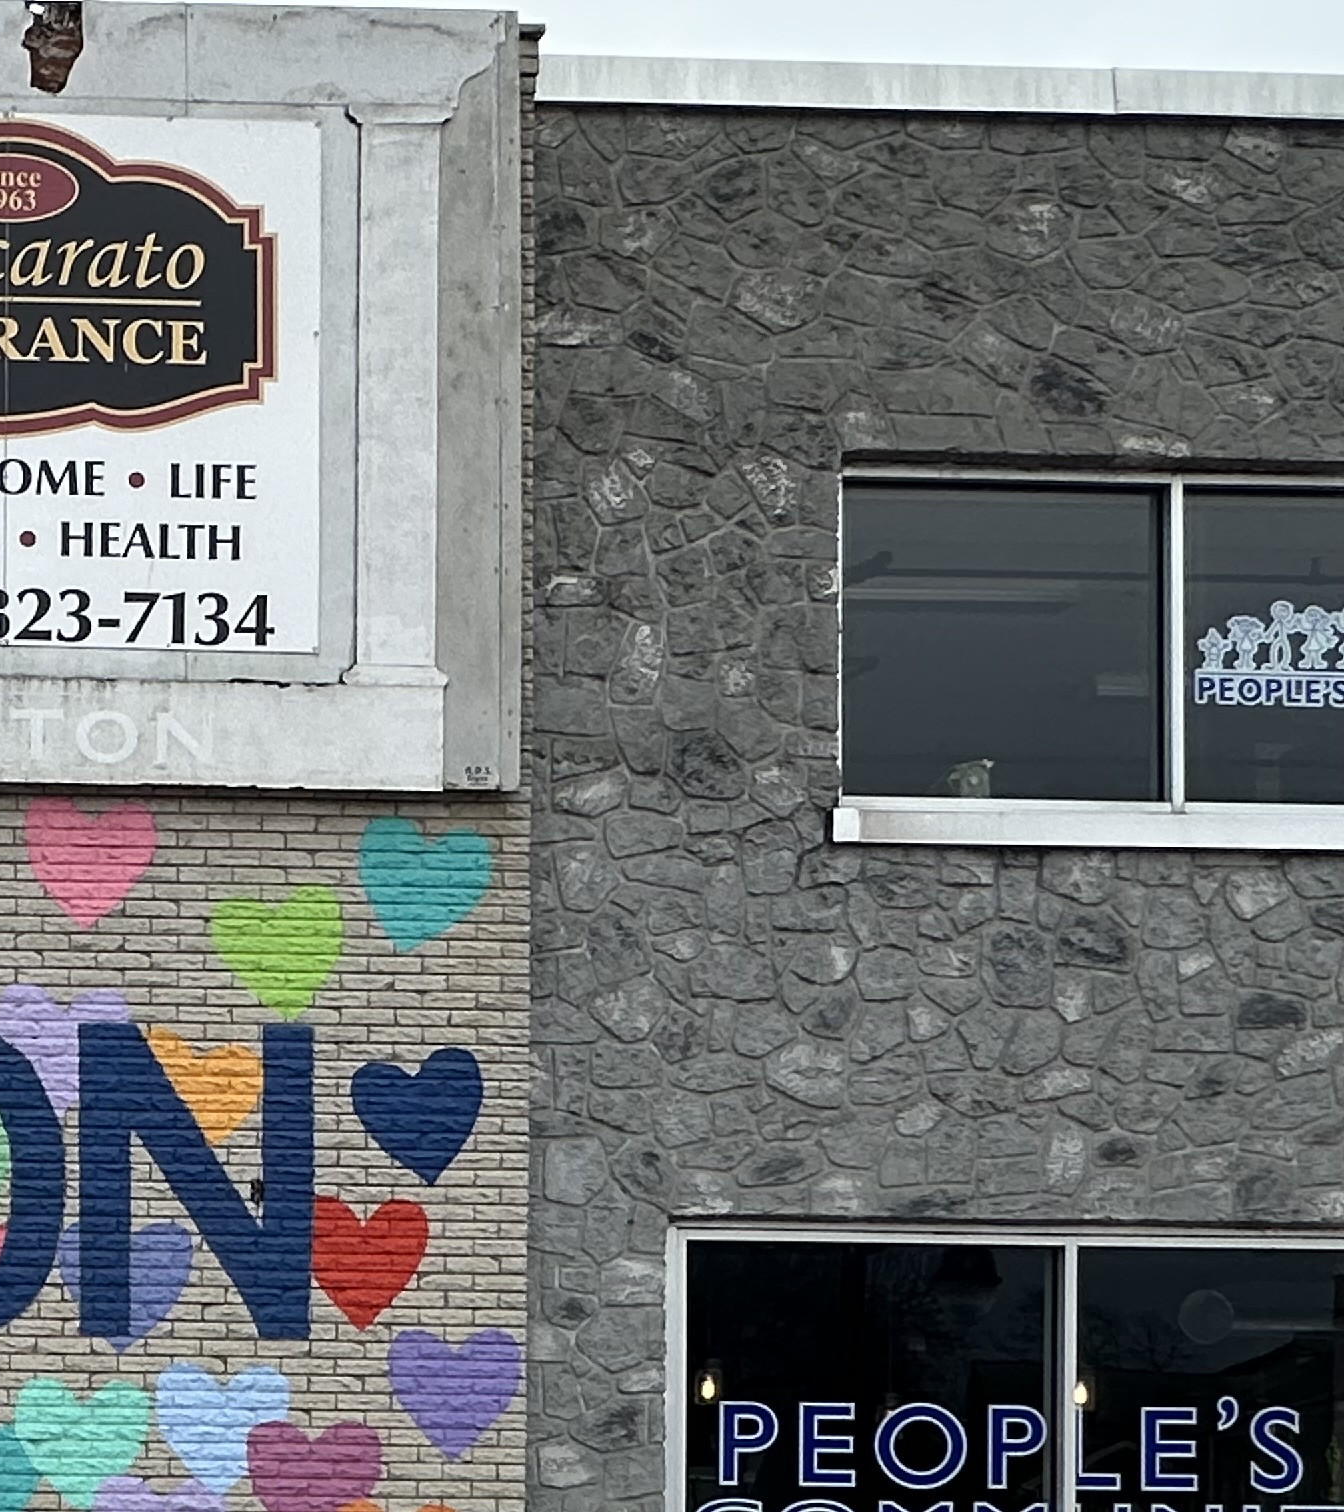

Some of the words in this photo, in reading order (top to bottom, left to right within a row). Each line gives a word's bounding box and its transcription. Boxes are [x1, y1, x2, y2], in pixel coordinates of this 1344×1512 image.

[169, 462, 258, 501] LIFE
[59, 520, 243, 561] HEALTH
[717, 1396, 1304, 1494] PEOPLE'S
